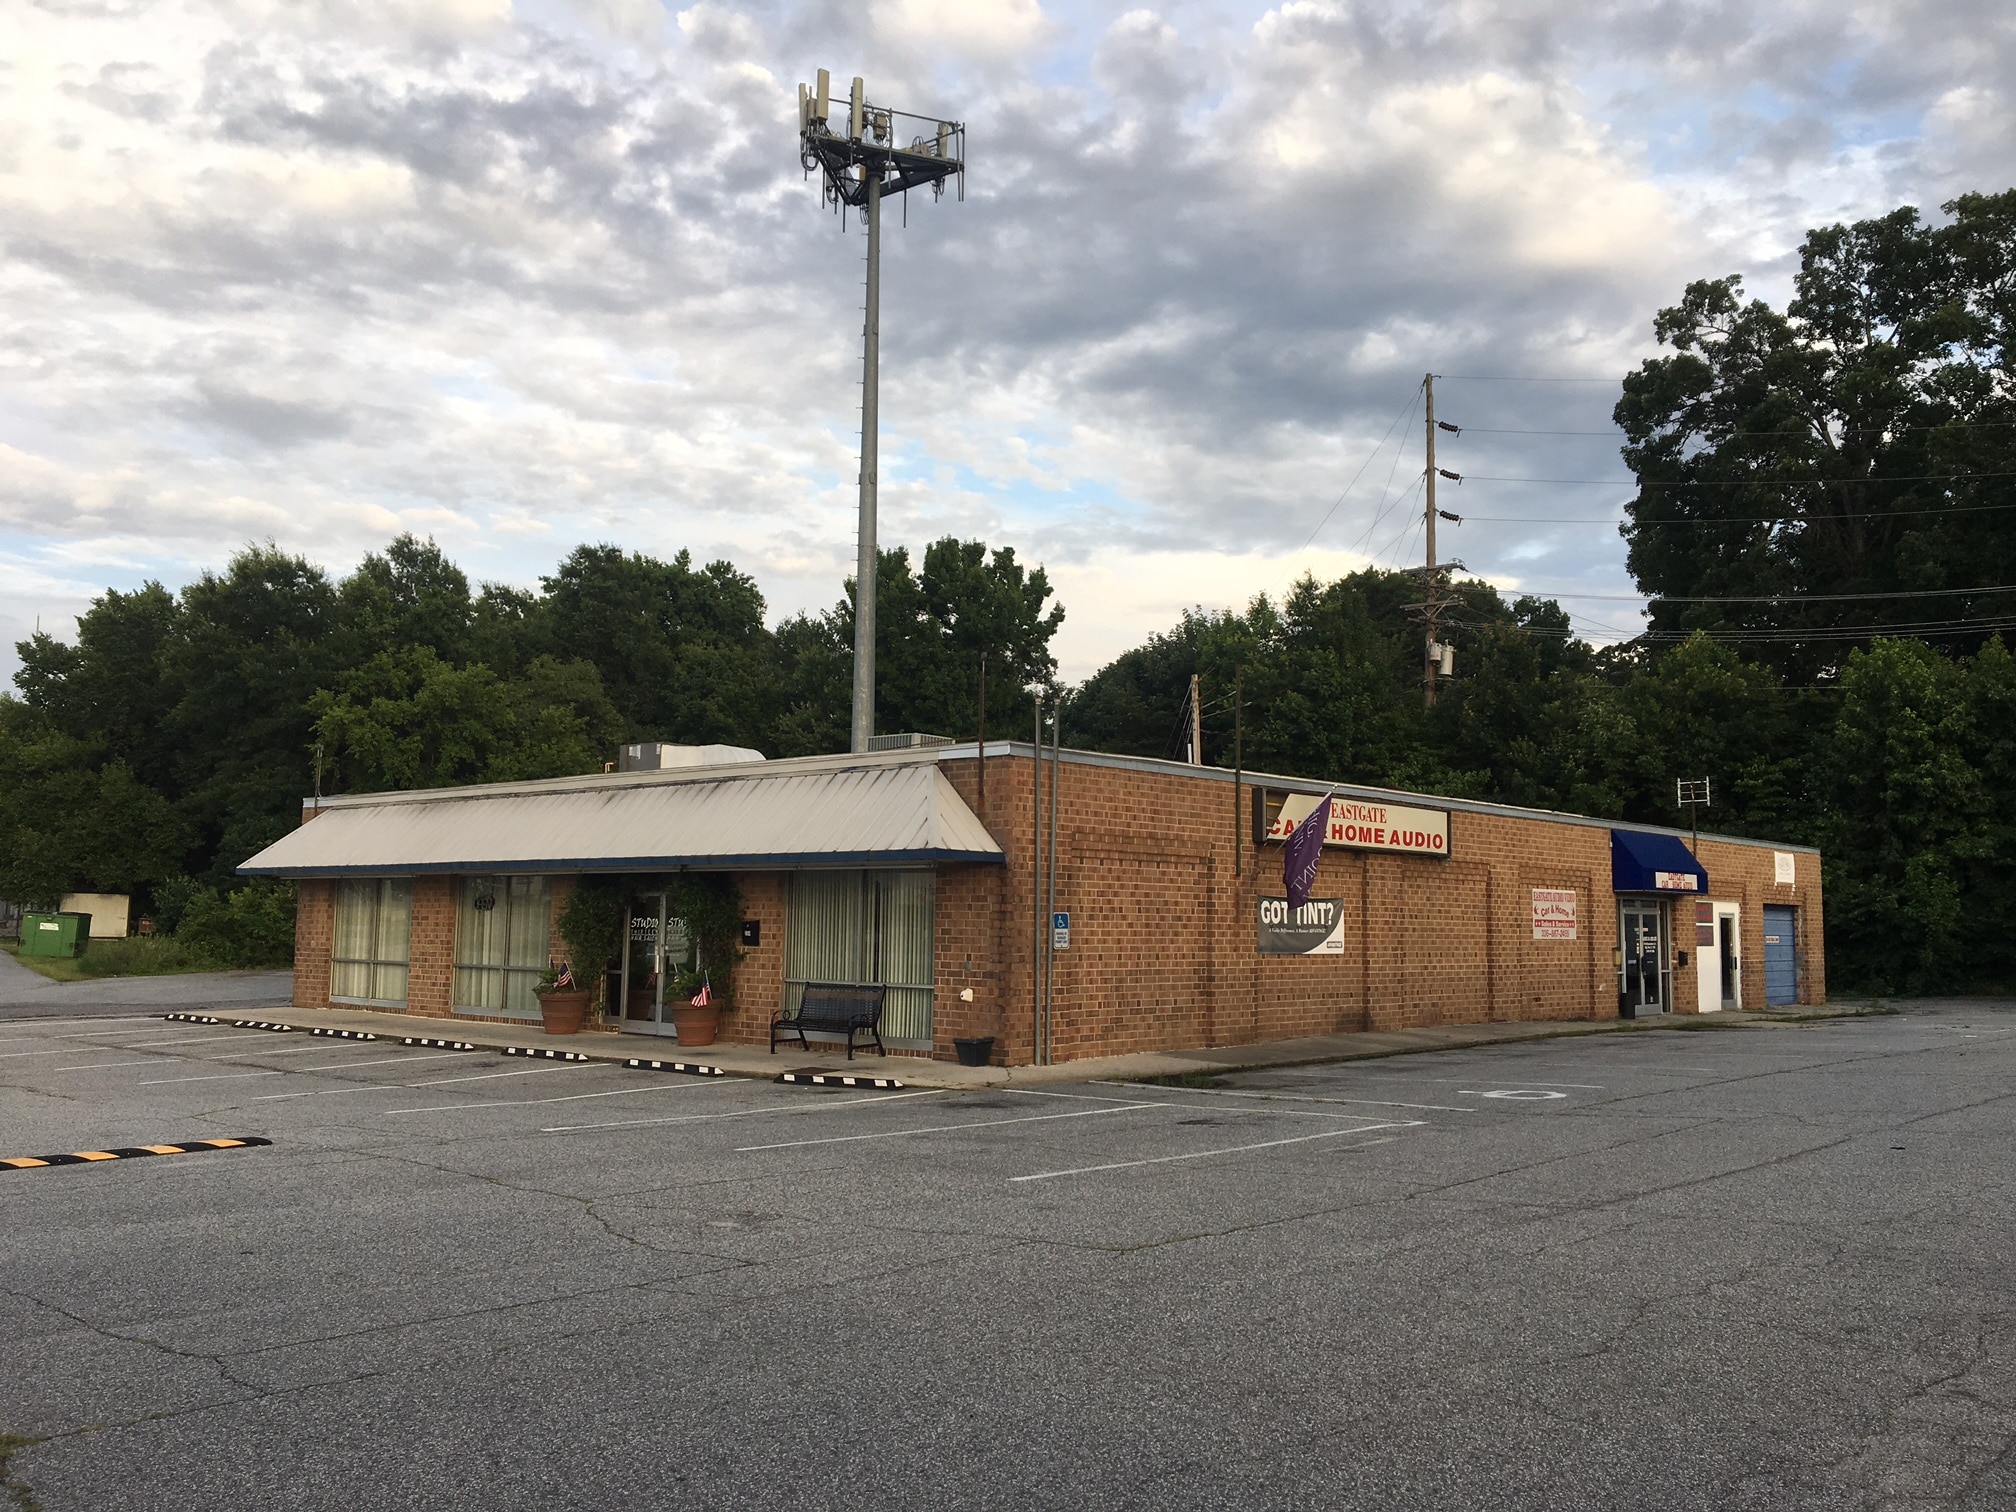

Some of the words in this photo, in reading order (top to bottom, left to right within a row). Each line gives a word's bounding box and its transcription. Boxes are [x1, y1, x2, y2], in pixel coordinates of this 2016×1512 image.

[1331, 803, 1387, 824] EASTGATE
[1269, 819, 1304, 838] CA
[1332, 824, 1385, 844] HOME
[1390, 830, 1443, 849] AUDIO
[1297, 902, 1334, 925] TINT?
